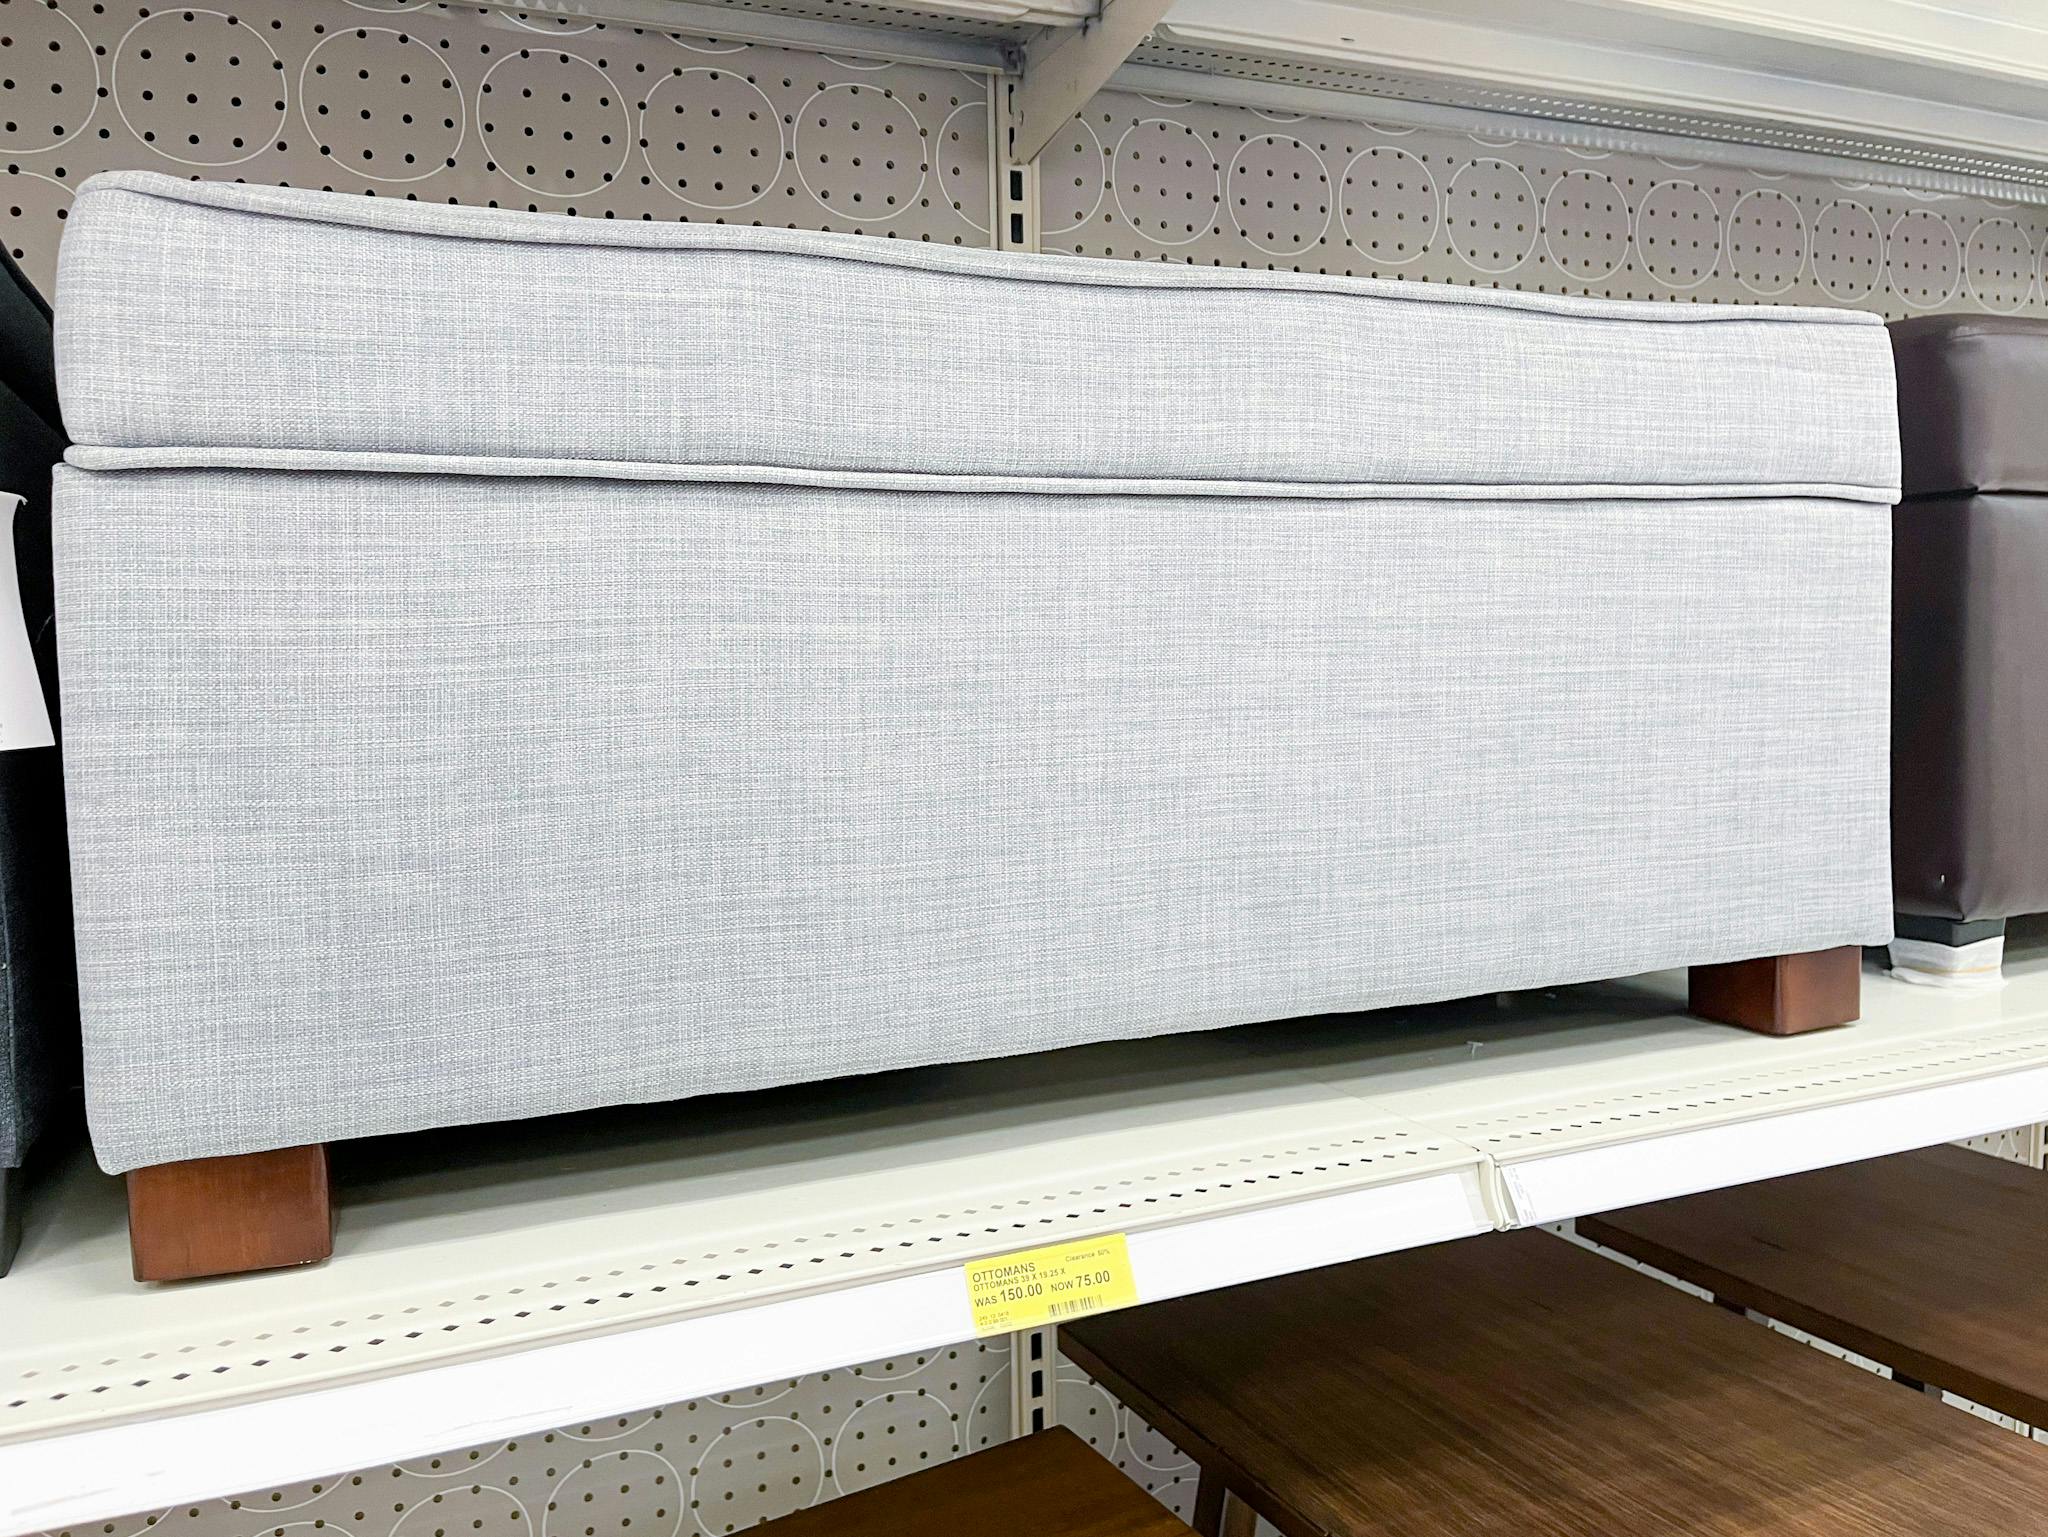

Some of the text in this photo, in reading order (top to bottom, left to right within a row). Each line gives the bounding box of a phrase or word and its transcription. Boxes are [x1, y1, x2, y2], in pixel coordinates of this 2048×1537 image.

[972, 1262, 1036, 1284] OTTOMANS
[973, 1277, 1020, 1292] OTTOMANS
[975, 1270, 1110, 1308] WAS 150.00 NOW 75.00
